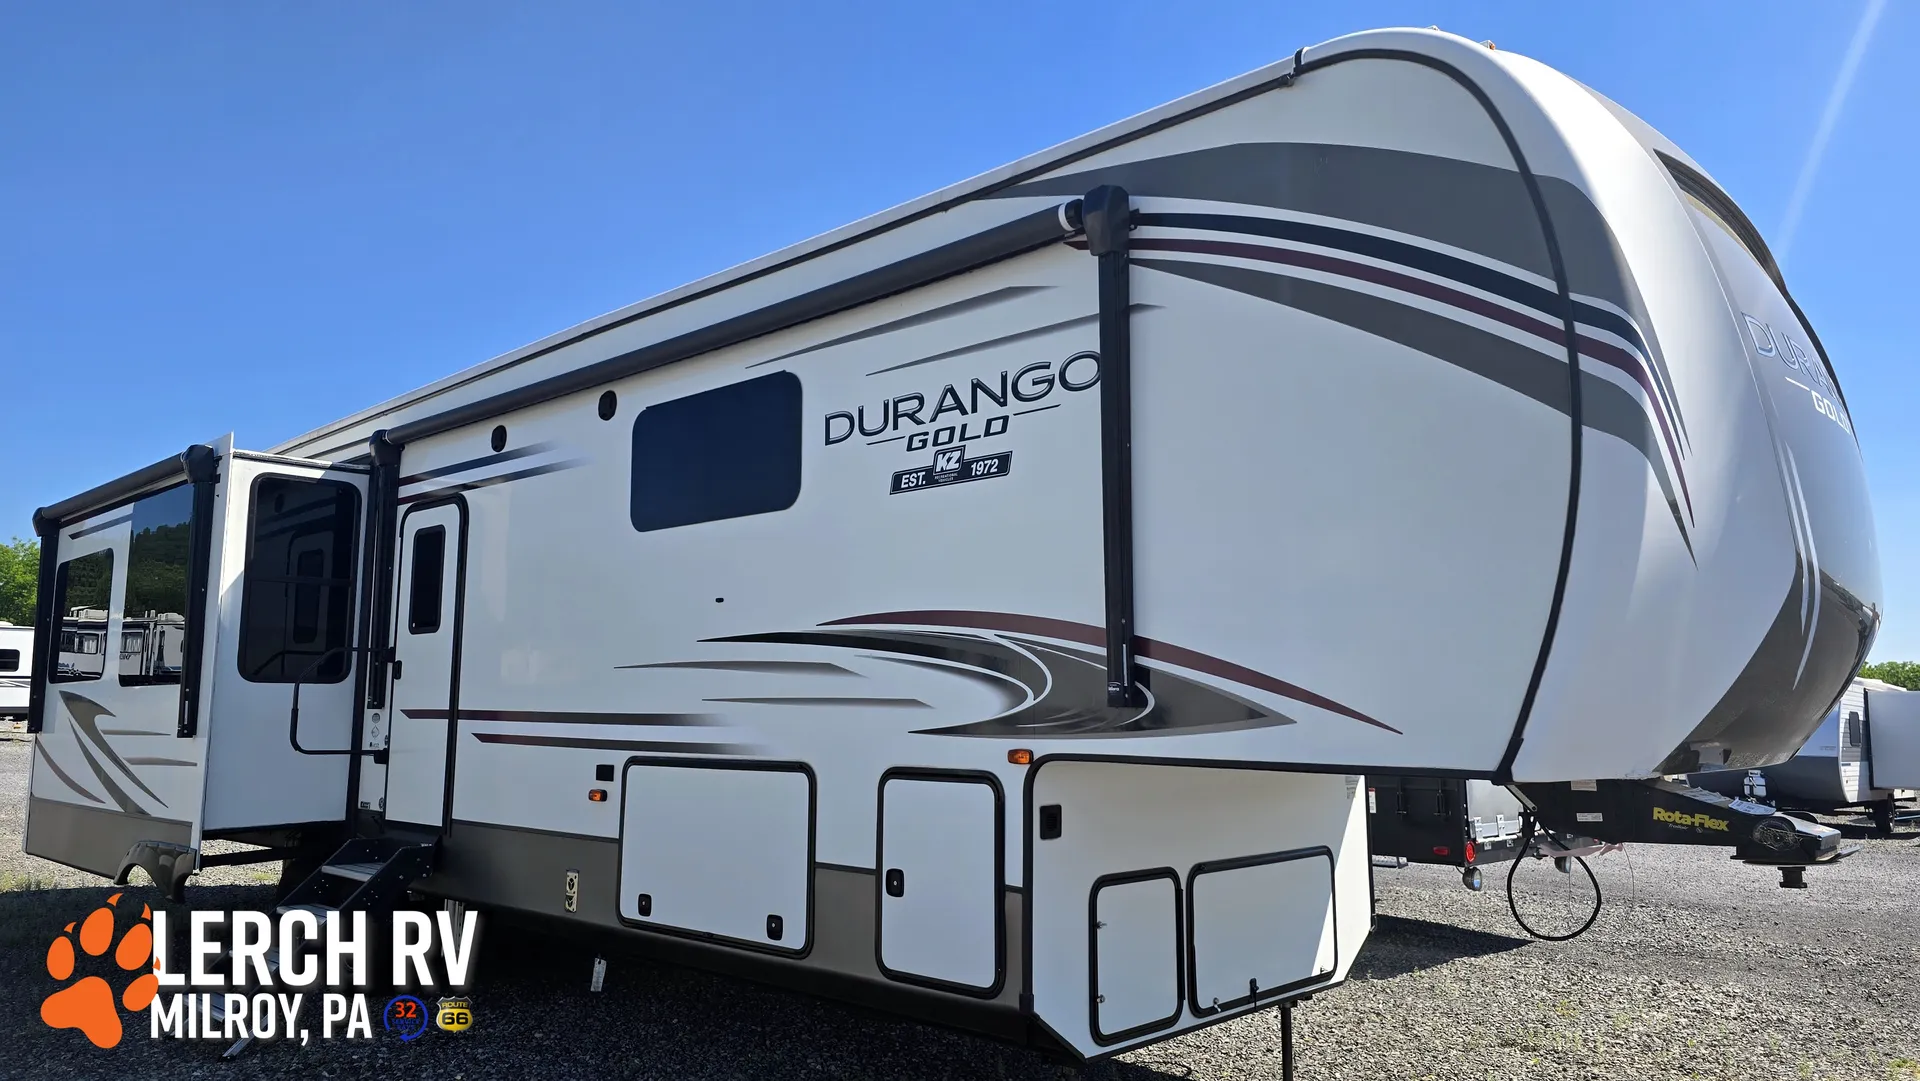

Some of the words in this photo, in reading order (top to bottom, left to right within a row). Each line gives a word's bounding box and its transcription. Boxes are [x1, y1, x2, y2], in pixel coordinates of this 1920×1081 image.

[825, 350, 1100, 446] DURANGO
[1811, 390, 1851, 435] GOLD
[906, 415, 1009, 452] GOLD
[901, 472, 926, 488] EST.
[971, 459, 999, 476] 1972
[935, 450, 962, 473] KZ
